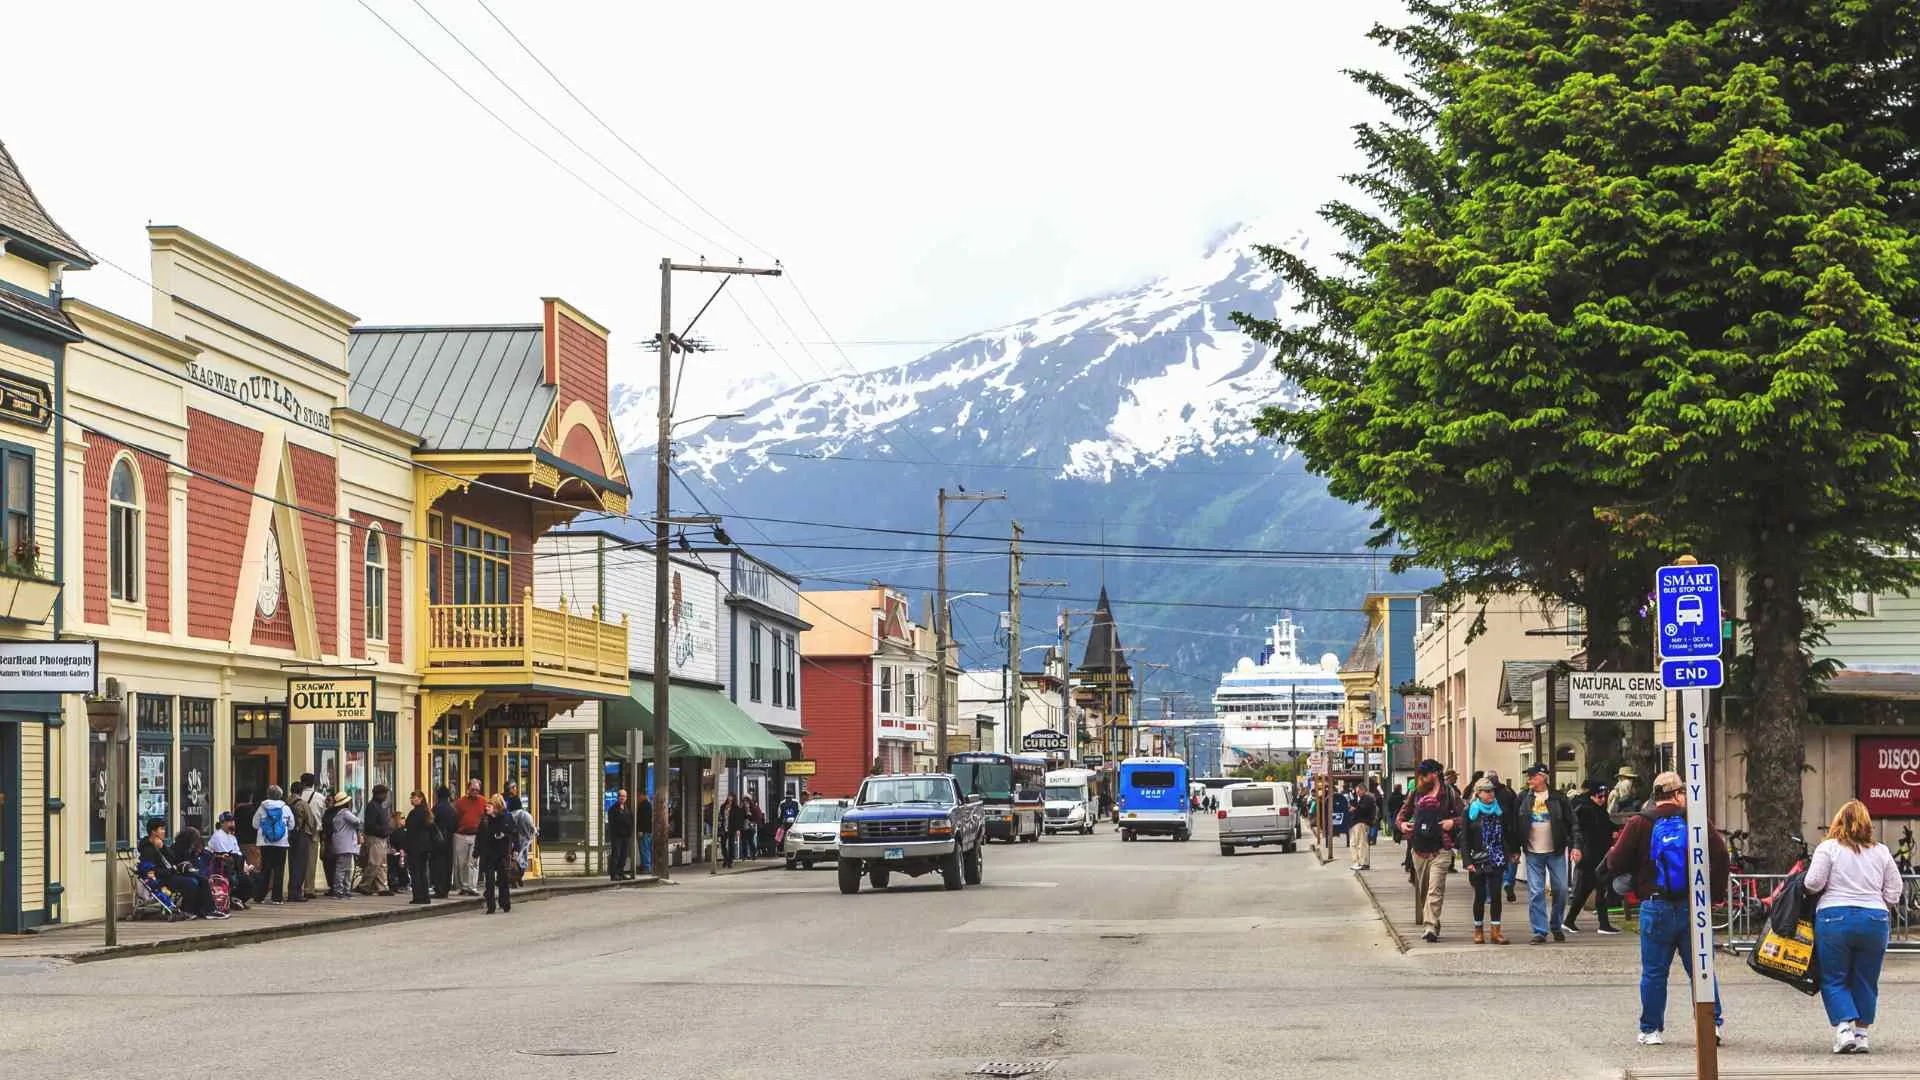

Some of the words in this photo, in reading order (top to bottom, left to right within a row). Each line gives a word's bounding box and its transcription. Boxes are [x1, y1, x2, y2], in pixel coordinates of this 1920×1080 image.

[185, 361, 237, 395] SKAGWAY
[240, 376, 300, 421] OUTLET
[303, 407, 330, 431] STORE
[1663, 574, 1713, 586] SMART
[40, 655, 92, 666] Photography
[1675, 668, 1708, 680] END
[296, 683, 335, 691] SKAGWAY
[1572, 677, 1625, 690] NATURAL
[1628, 677, 1662, 691] GEMS
[293, 691, 369, 709] OUTLET
[336, 709, 366, 717] STORE
[1024, 738, 1067, 748] CURIOS
[1688, 720, 1702, 802] CITY
[1870, 788, 1911, 799] SKAGWAY
[1693, 826, 1709, 971] TRANSIT
